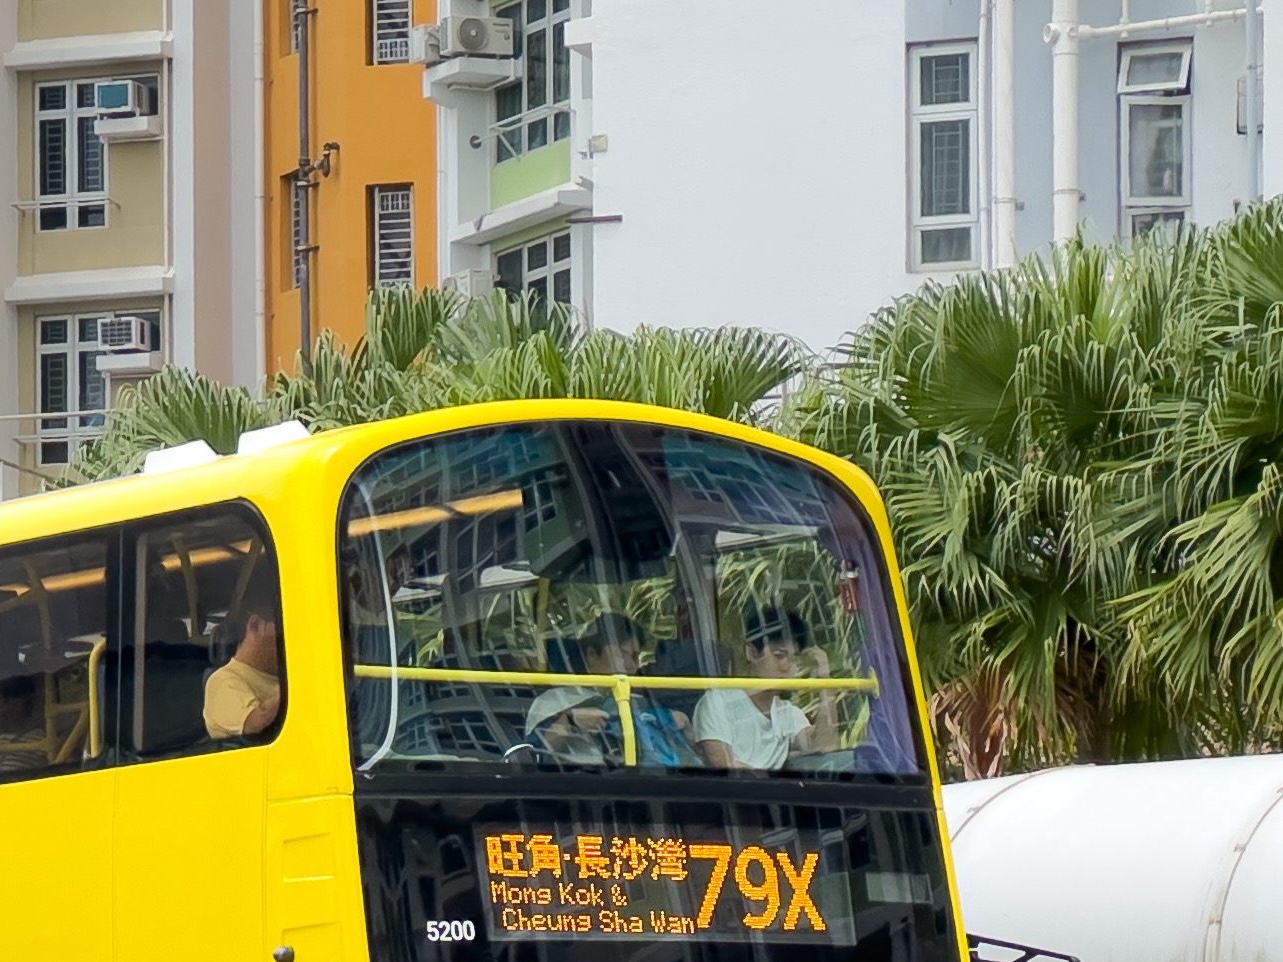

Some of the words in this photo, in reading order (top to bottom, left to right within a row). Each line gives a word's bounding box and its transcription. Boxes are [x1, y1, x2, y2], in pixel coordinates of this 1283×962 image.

[491, 881, 551, 904] Mong
[559, 883, 604, 905] Kok
[612, 886, 628, 907] &
[689, 844, 826, 931] 79X
[427, 920, 475, 941] 5200
[502, 908, 592, 933] Cheung
[599, 911, 643, 933] Sha
[650, 911, 696, 934] Wan
